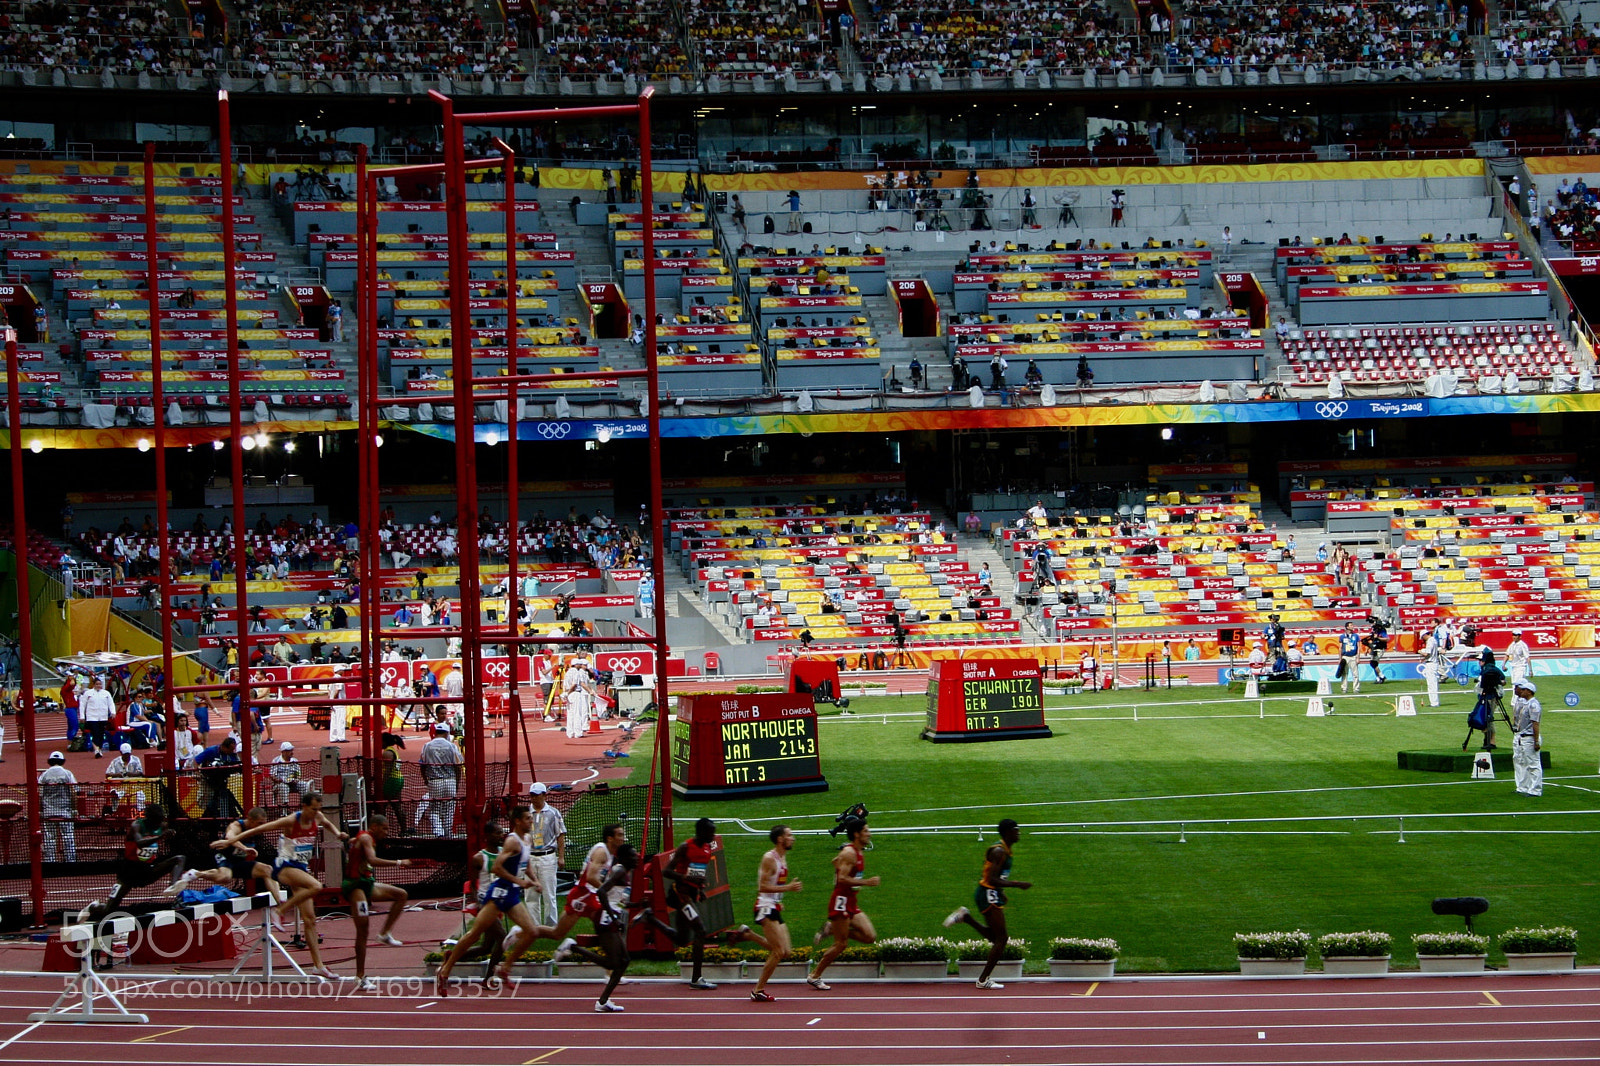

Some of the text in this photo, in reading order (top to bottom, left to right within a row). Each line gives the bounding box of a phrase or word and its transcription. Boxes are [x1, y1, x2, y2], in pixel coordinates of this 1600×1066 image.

[1370, 403, 1422, 414] Beijing 2008
[593, 423, 647, 435] Beijing 2008
[1233, 630, 1240, 640] 6
[989, 667, 996, 677] A
[964, 679, 1032, 695] SCHWANITZ
[965, 695, 1039, 711] GER 1901
[1312, 702, 1319, 712] 17
[1402, 700, 1410, 710] 19
[722, 706, 759, 720] SHOT PUT B
[725, 739, 815, 760] JAM 2143
[838, 898, 844, 909] 2
[684, 906, 692, 918] 7
